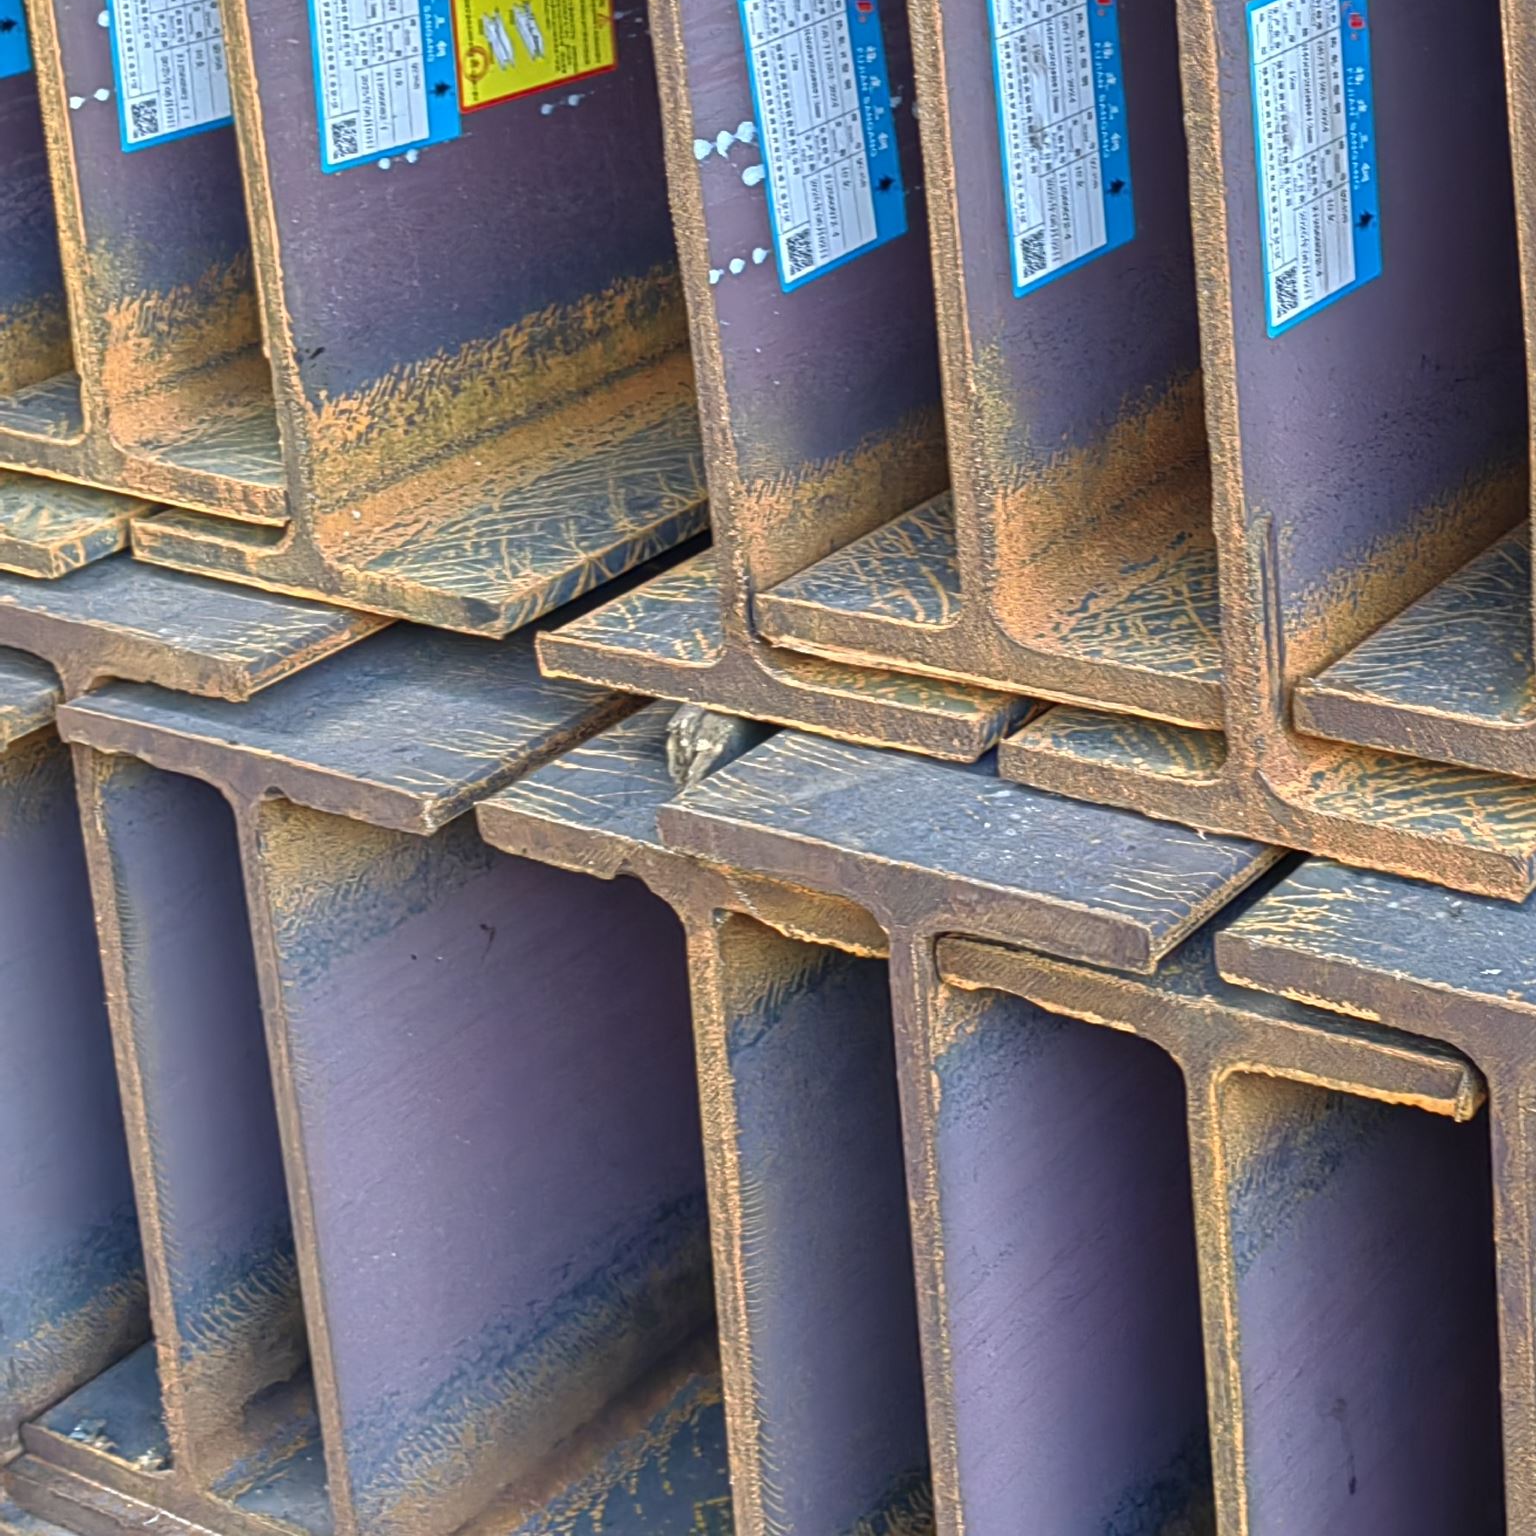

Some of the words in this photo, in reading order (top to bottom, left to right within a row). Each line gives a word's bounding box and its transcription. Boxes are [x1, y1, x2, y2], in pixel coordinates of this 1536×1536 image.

[864, 43, 889, 151] 福建三钢
[1102, 39, 1121, 152] 福建三钢
